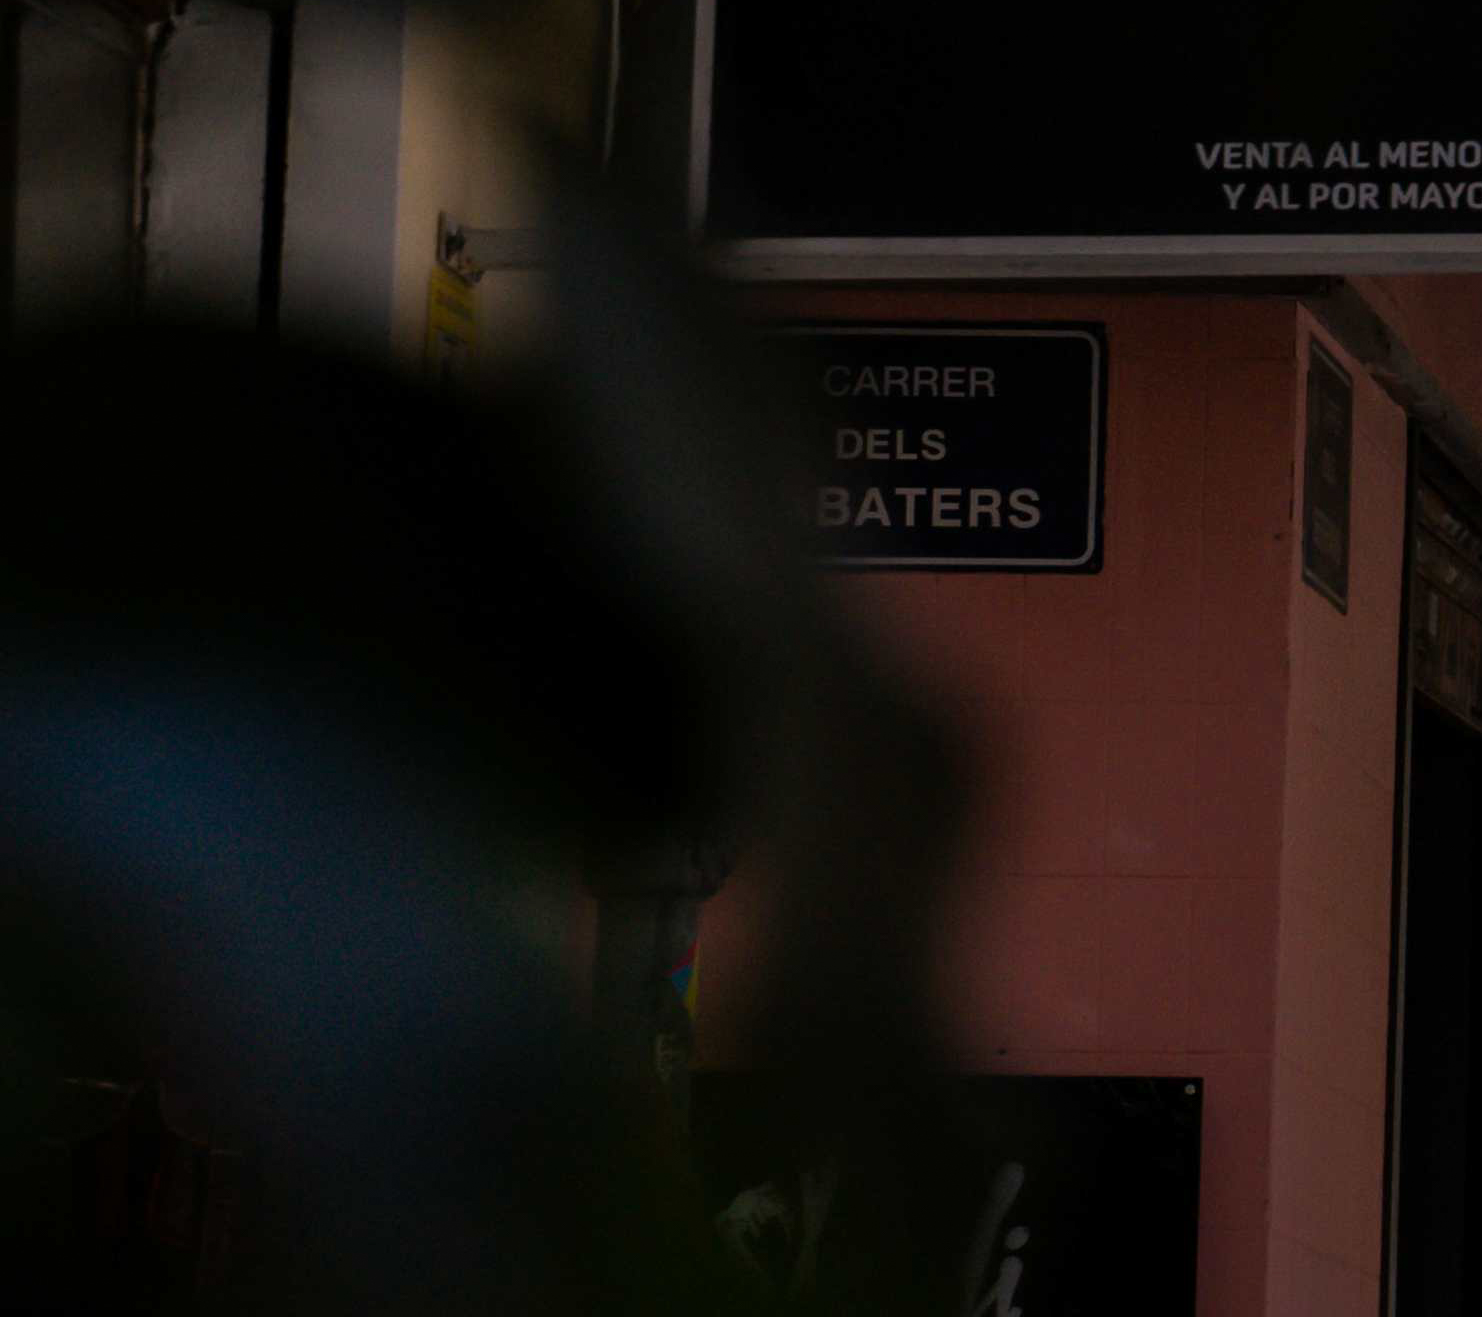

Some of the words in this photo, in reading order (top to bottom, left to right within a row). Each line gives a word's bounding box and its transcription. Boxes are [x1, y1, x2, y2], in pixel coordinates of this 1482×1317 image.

[1195, 141, 1313, 169] VENTA
[1323, 140, 1370, 168] AL
[1222, 182, 1246, 210] Y
[1253, 182, 1300, 210] AL
[1309, 182, 1379, 210] POR
[822, 365, 996, 398] CARRER
[835, 428, 947, 461] DELS
[813, 486, 1041, 529] BATERS
